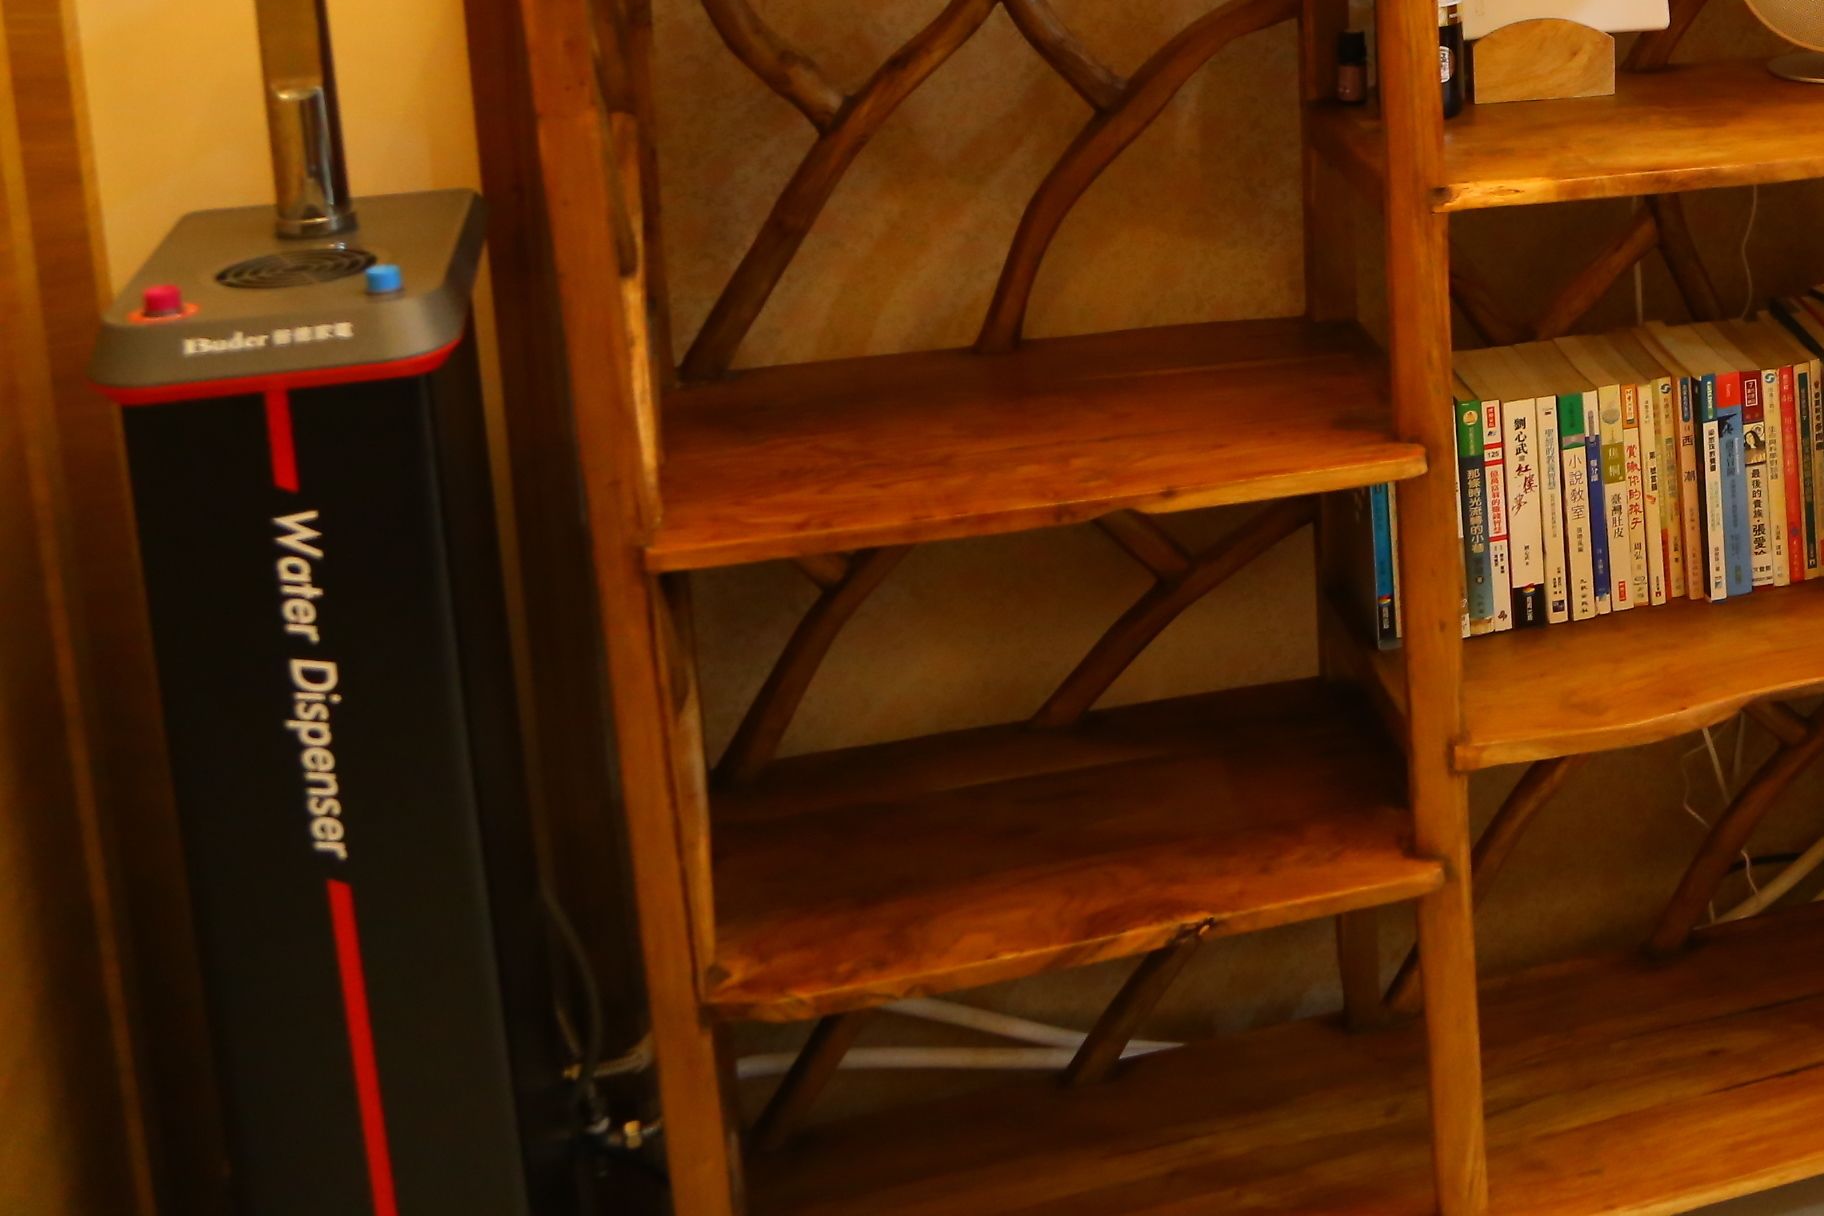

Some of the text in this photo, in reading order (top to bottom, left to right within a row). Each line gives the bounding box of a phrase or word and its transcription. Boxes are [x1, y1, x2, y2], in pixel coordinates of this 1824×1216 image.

[1514, 417, 1528, 456] 劉心武
[1569, 454, 1585, 520] 小說教室
[272, 510, 348, 861] Water Dispenser
